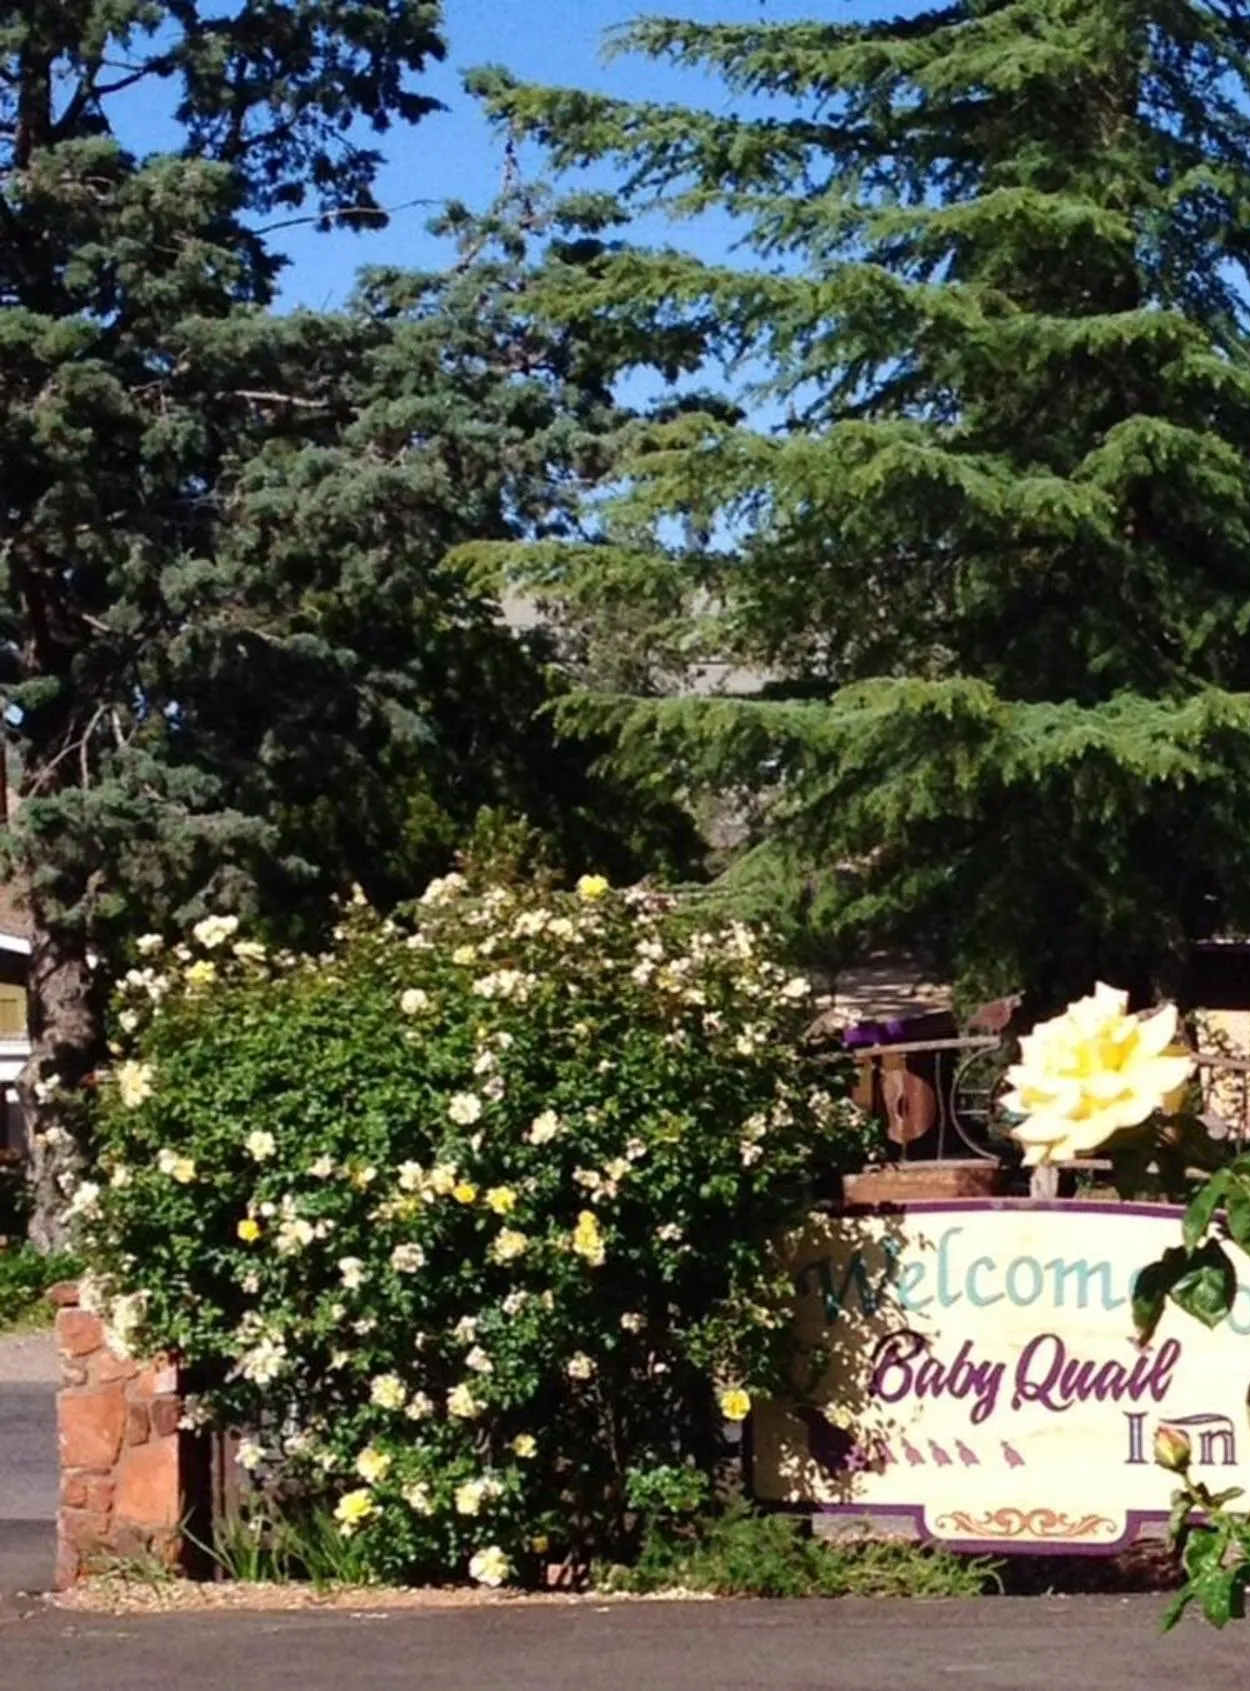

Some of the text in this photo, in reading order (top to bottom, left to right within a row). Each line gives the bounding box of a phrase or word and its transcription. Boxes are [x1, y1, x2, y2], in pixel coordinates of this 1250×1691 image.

[799, 1226, 1145, 1325] Welcom
[867, 1328, 1182, 1425] Baby Quail
[1121, 1410, 1239, 1466] In
